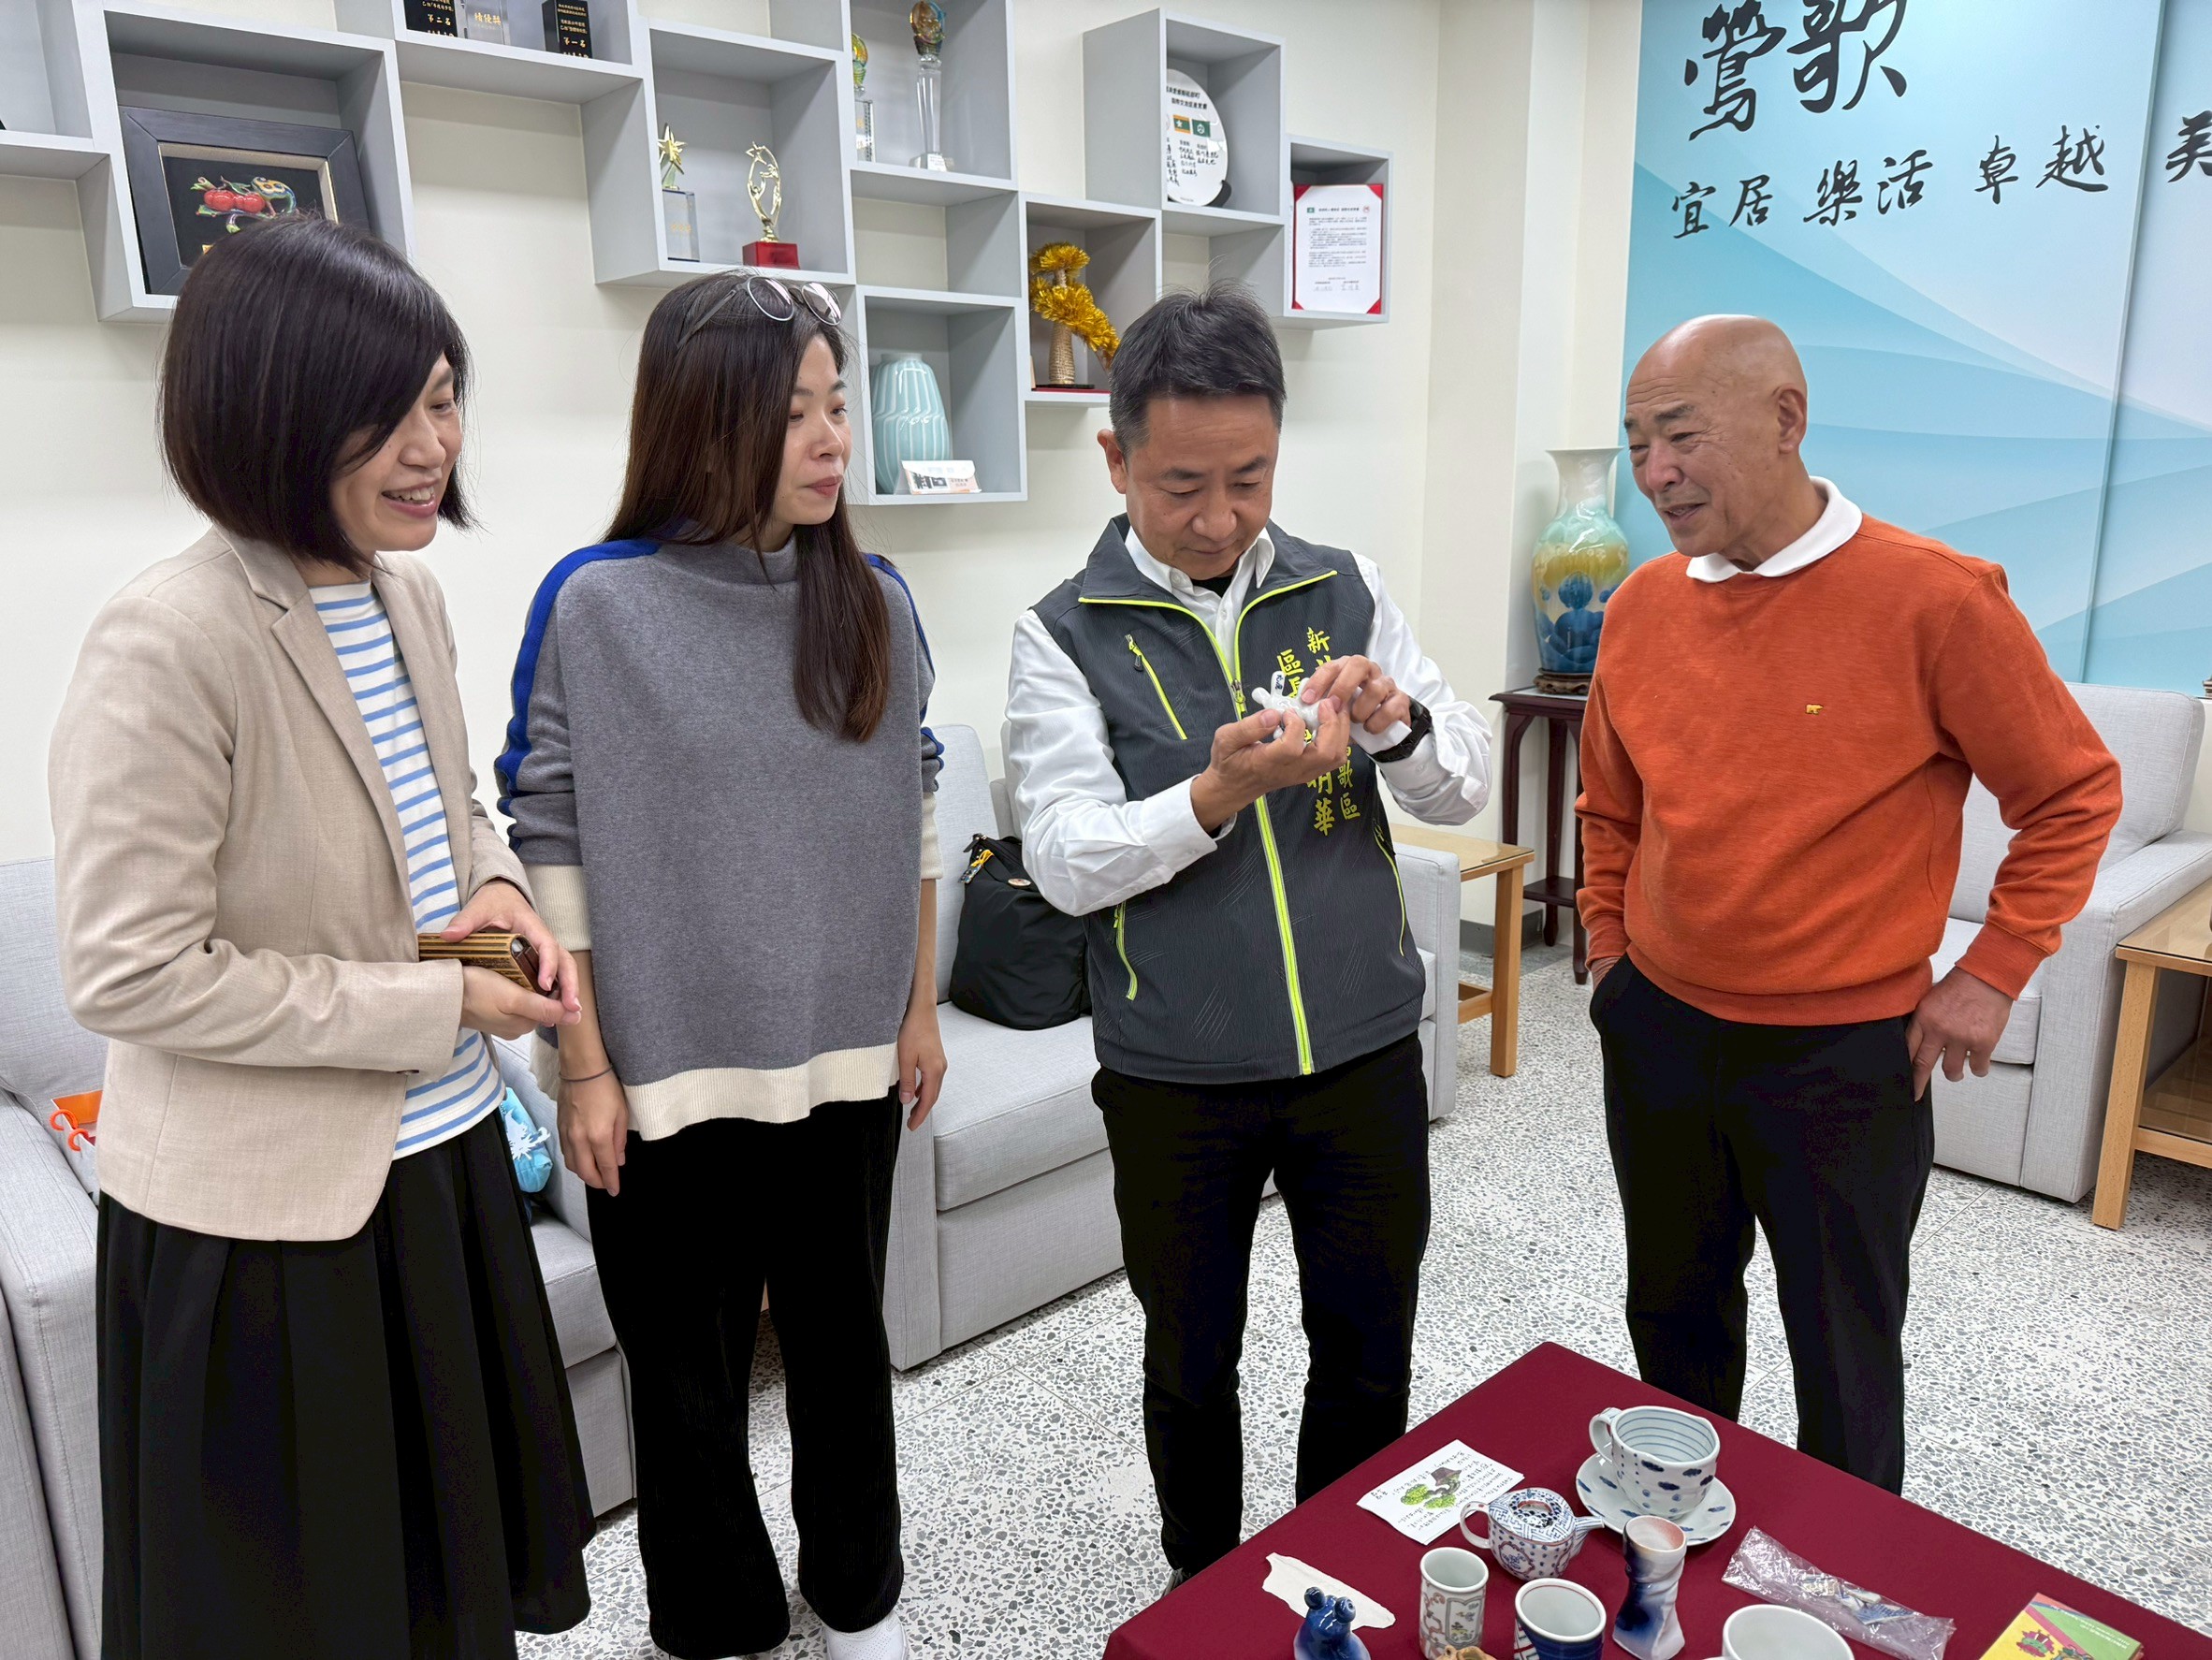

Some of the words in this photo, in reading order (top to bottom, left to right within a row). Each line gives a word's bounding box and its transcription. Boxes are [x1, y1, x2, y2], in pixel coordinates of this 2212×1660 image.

[1683, 0, 1907, 141] 鶯歌
[1671, 174, 1773, 240] 宜居
[1803, 149, 1933, 226] 樂活
[1974, 124, 2109, 205] 卓越
